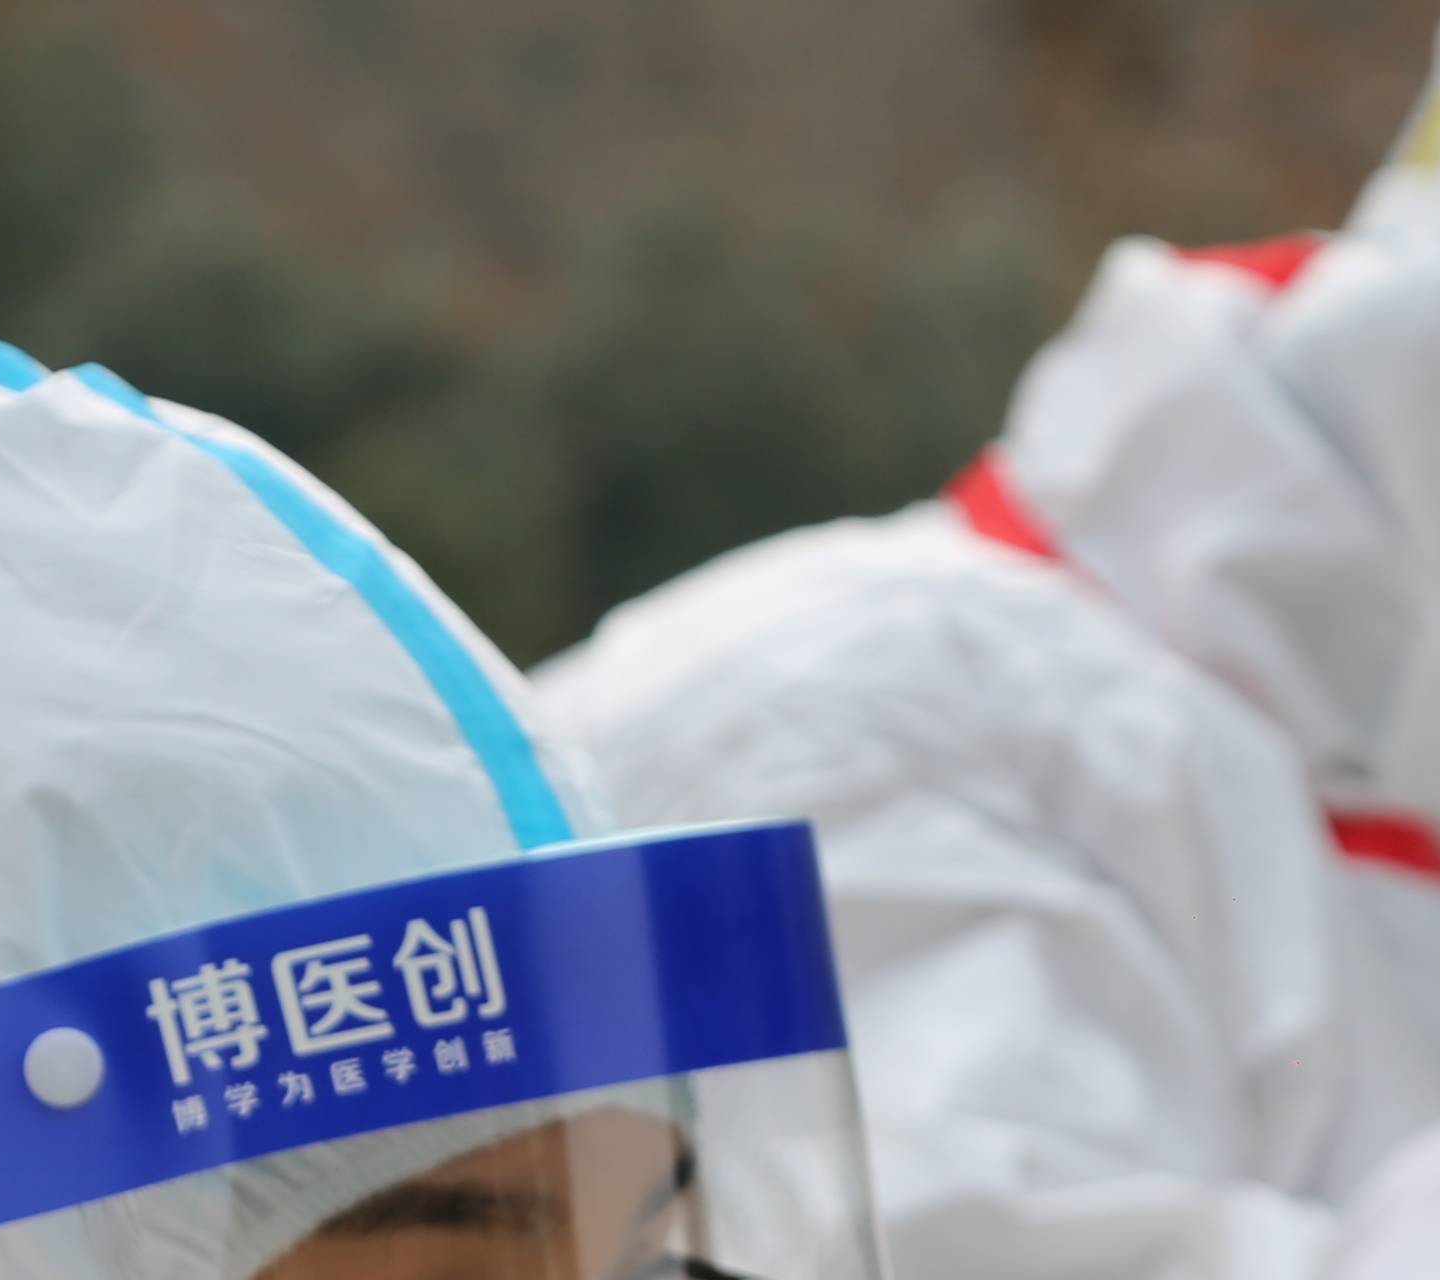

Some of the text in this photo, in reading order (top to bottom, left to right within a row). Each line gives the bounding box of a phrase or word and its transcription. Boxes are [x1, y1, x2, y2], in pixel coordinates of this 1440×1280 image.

[145, 905, 509, 1087] 博医创
[171, 1027, 518, 1134] 博学为医学创新
